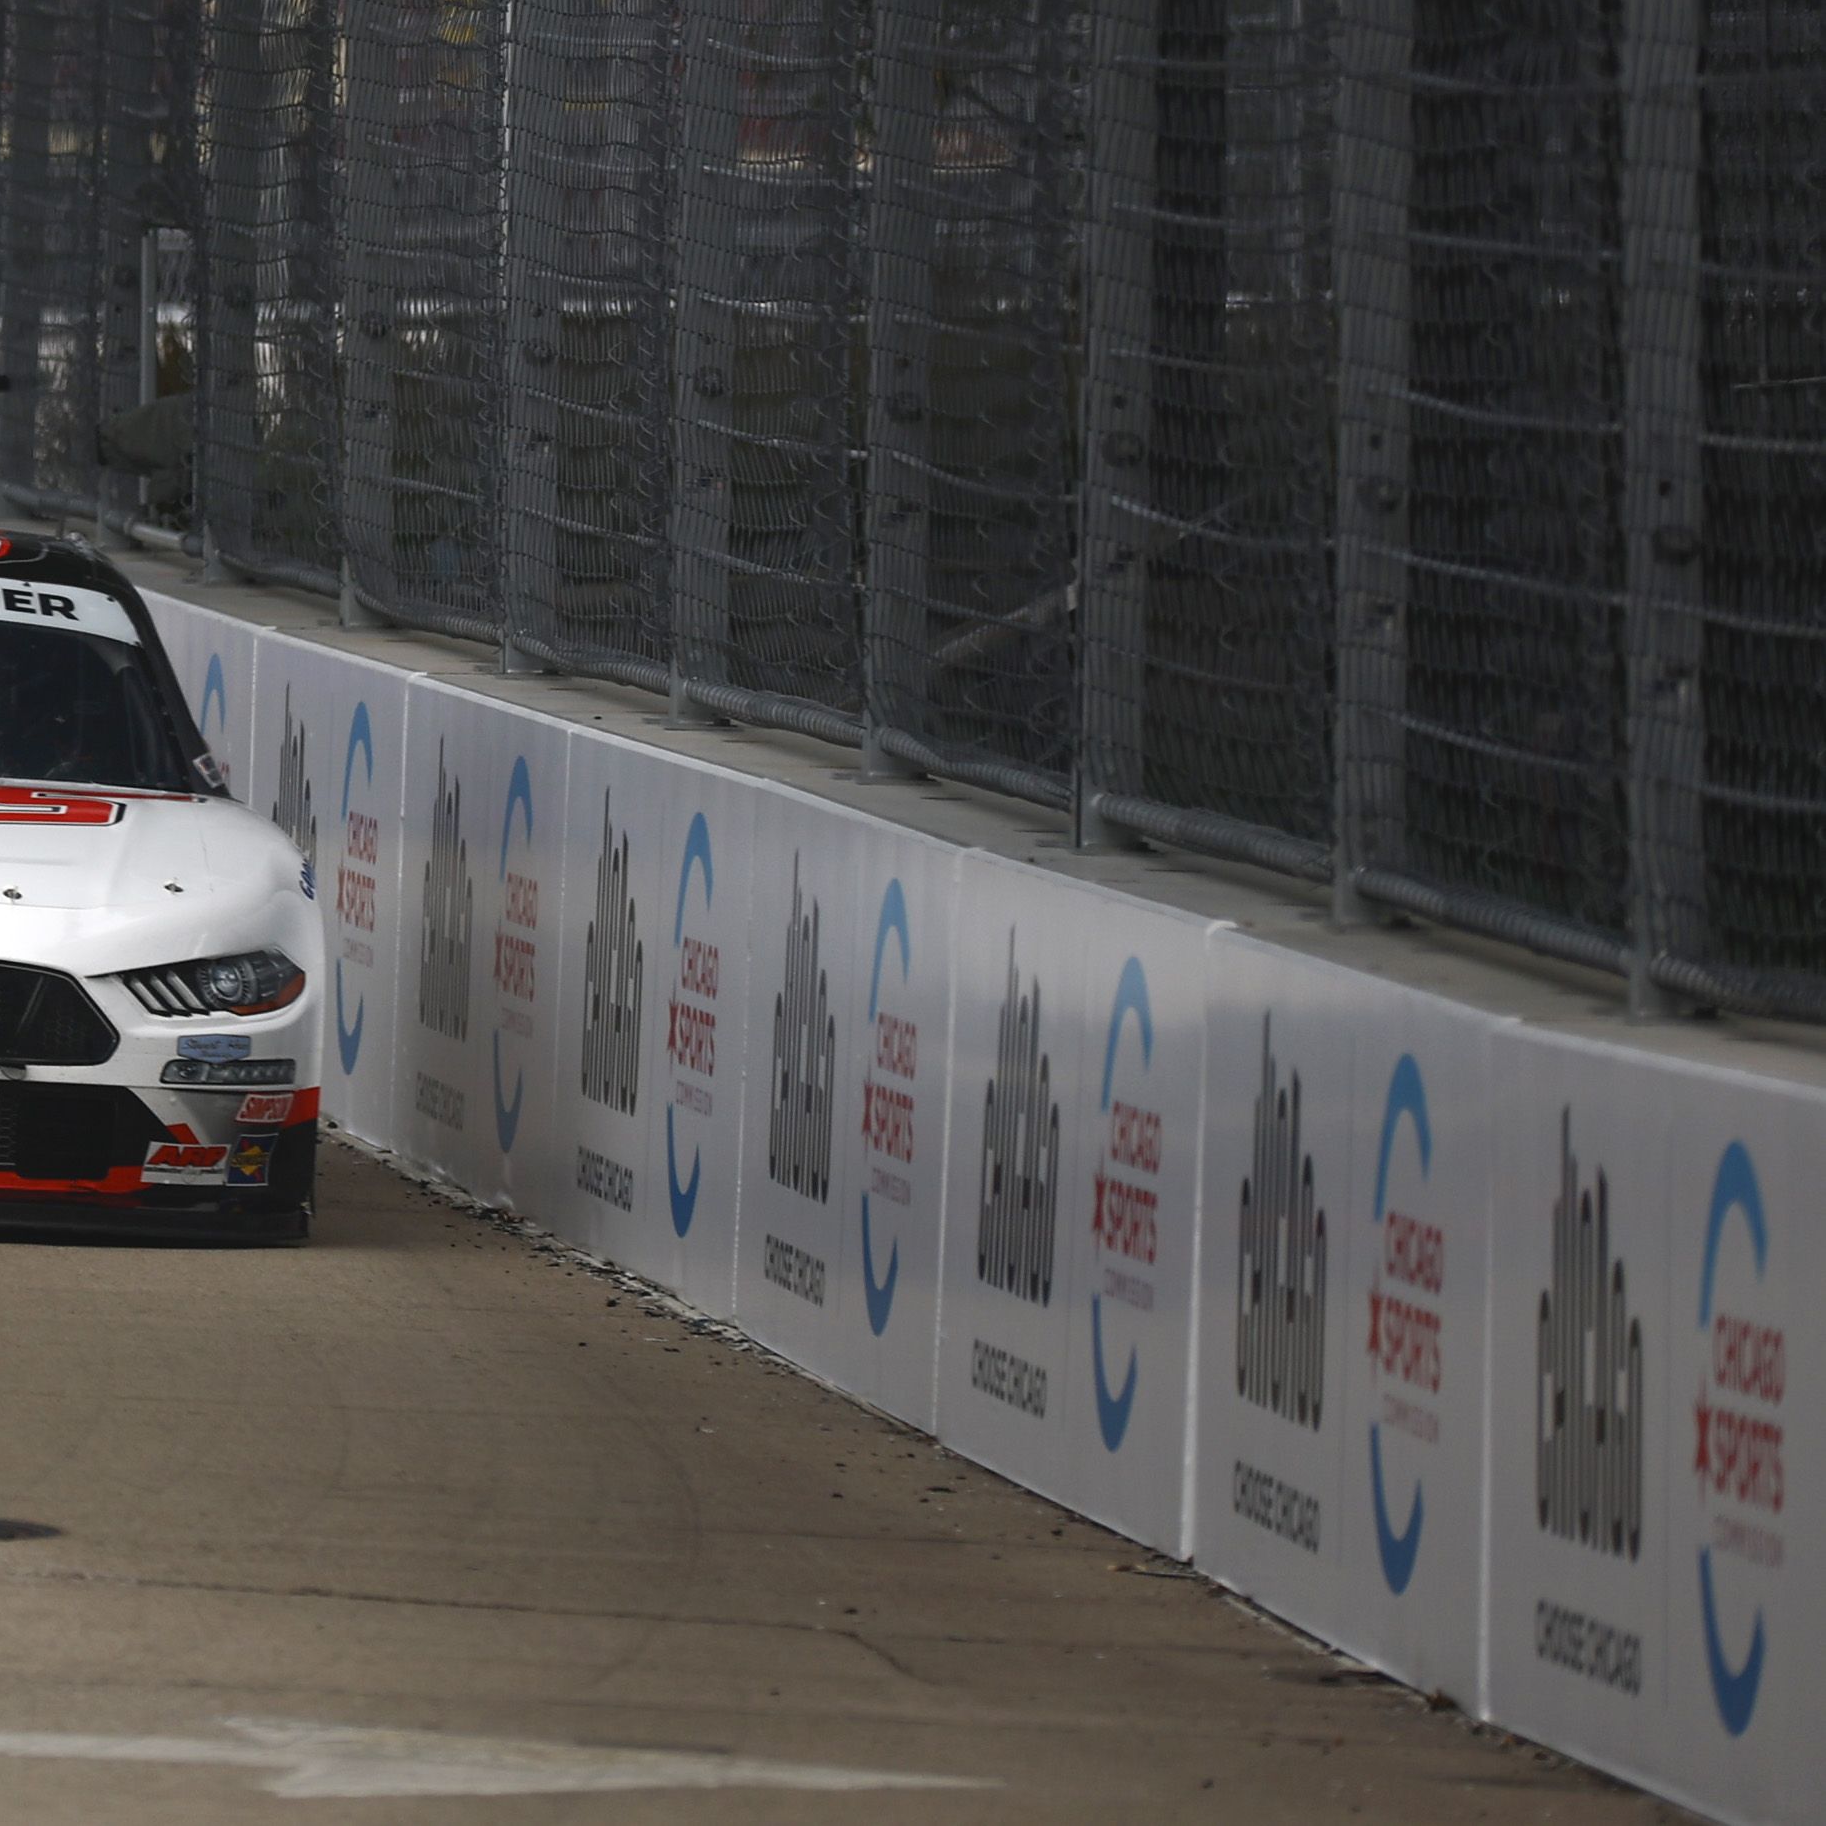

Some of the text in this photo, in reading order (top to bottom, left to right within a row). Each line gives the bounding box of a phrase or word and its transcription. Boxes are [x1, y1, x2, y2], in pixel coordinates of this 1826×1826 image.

[345, 869, 376, 933] SPORTS
[500, 934, 536, 1003] SPORTS
[677, 1002, 717, 1078] SPORTS
[872, 1081, 914, 1164] SPORTS
[1105, 1176, 1158, 1266] SPORTS
[1382, 1297, 1442, 1395] SPORTS
[1713, 1408, 1785, 1516] SPORTS
